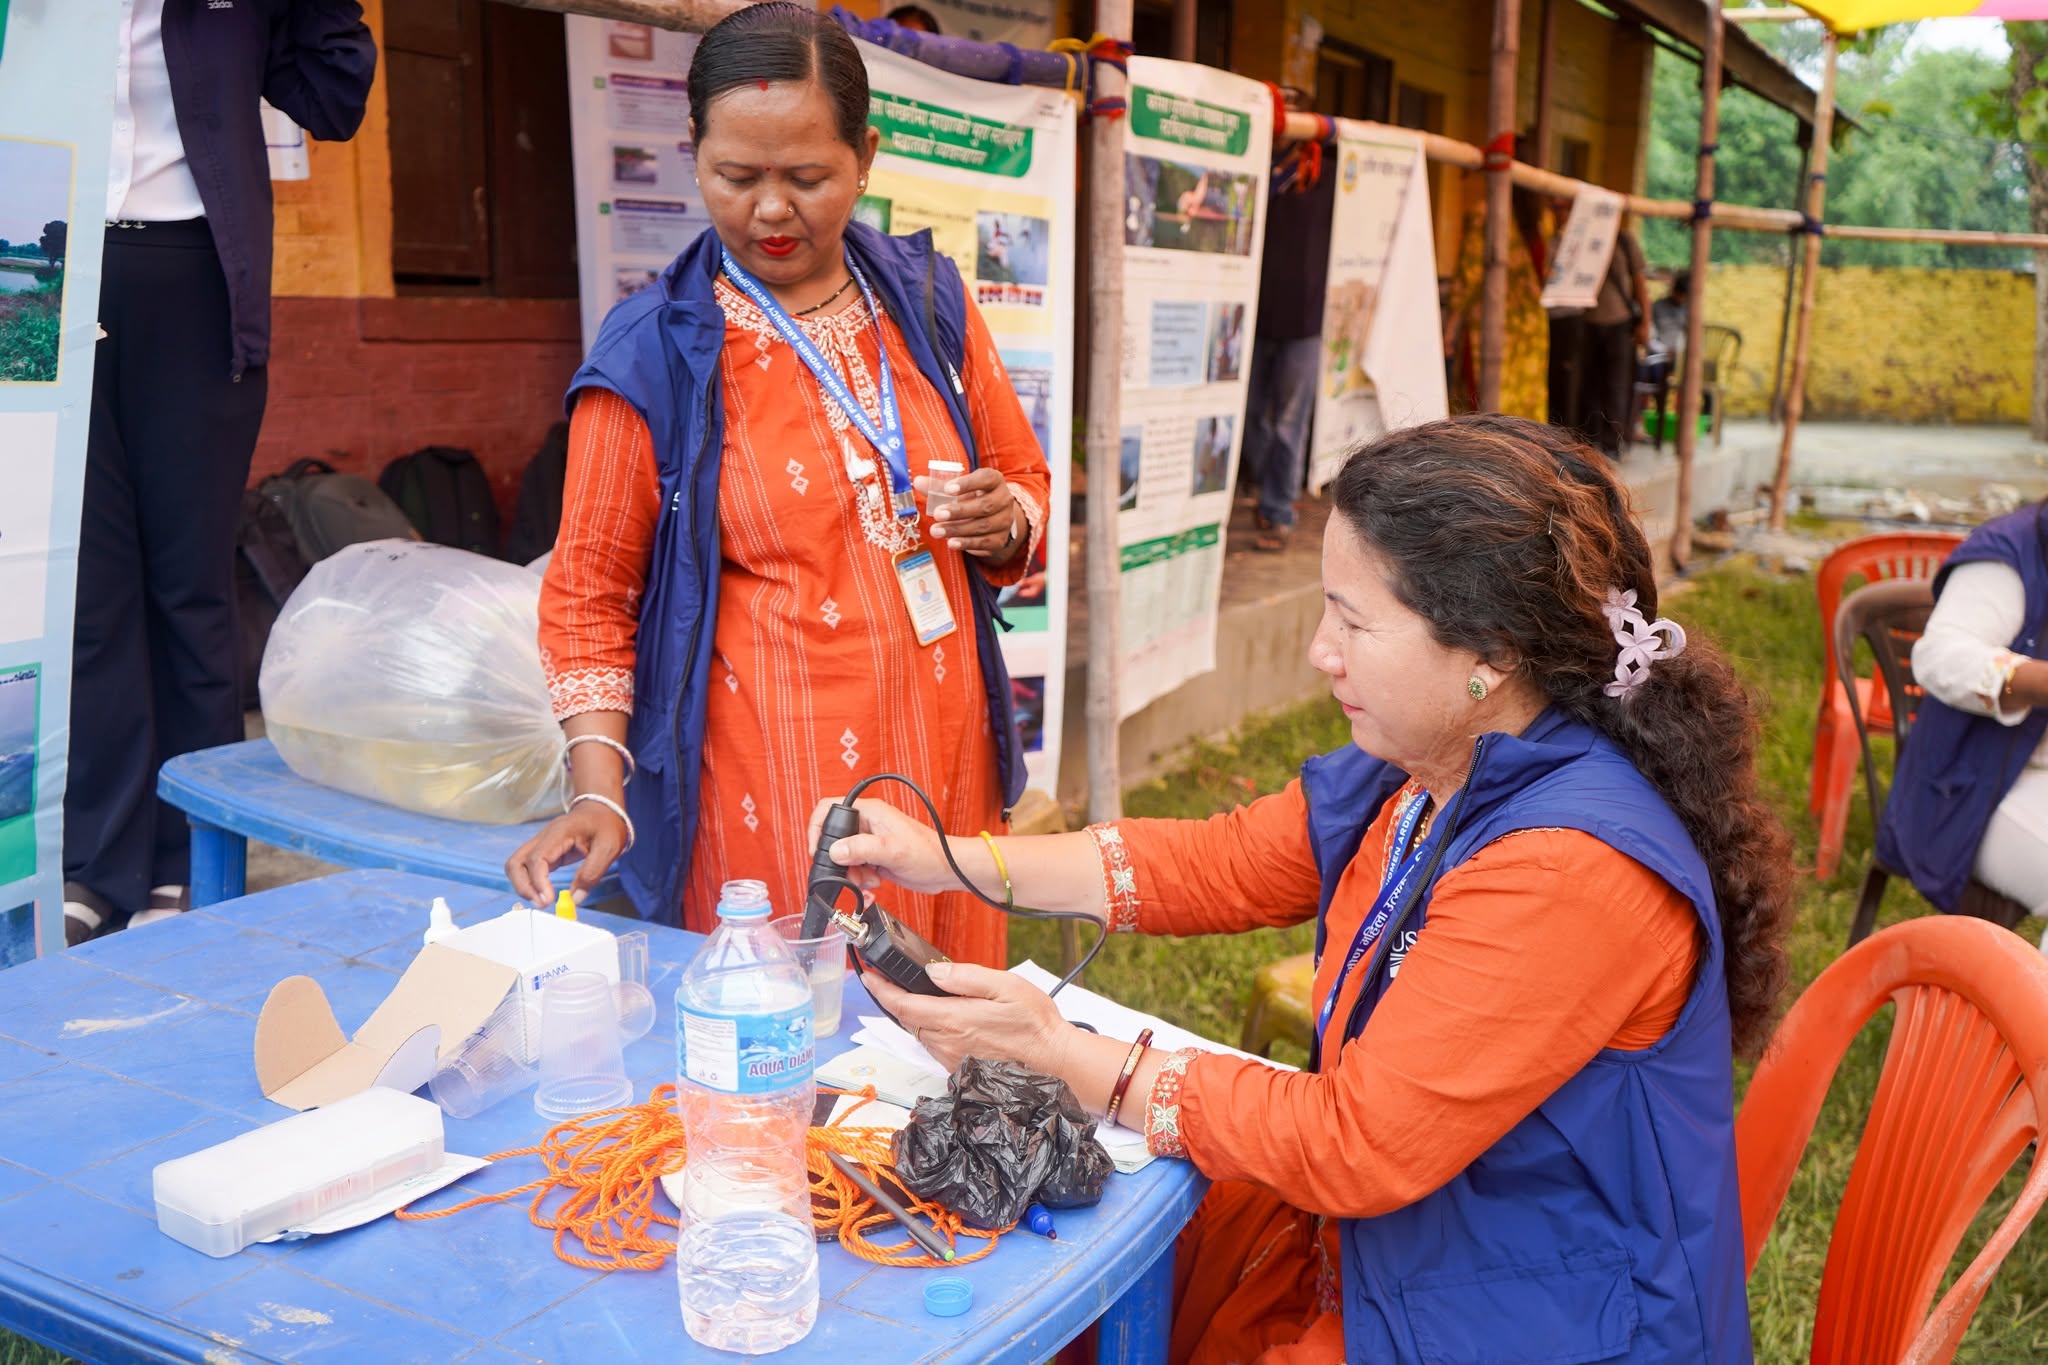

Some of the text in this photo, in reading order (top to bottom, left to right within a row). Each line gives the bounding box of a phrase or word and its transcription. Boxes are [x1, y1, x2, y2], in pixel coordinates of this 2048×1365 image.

[723, 257, 880, 441] FORUM FOR RURAL WOMEN ARDENCY DEVELOPMENT
[1398, 794, 1426, 845] ARDENCY
[1360, 911, 1389, 947] महिला
[541, 963, 569, 982] HANNA
[748, 1059, 785, 1077] AQUA
[788, 1045, 814, 1069] DIAM
